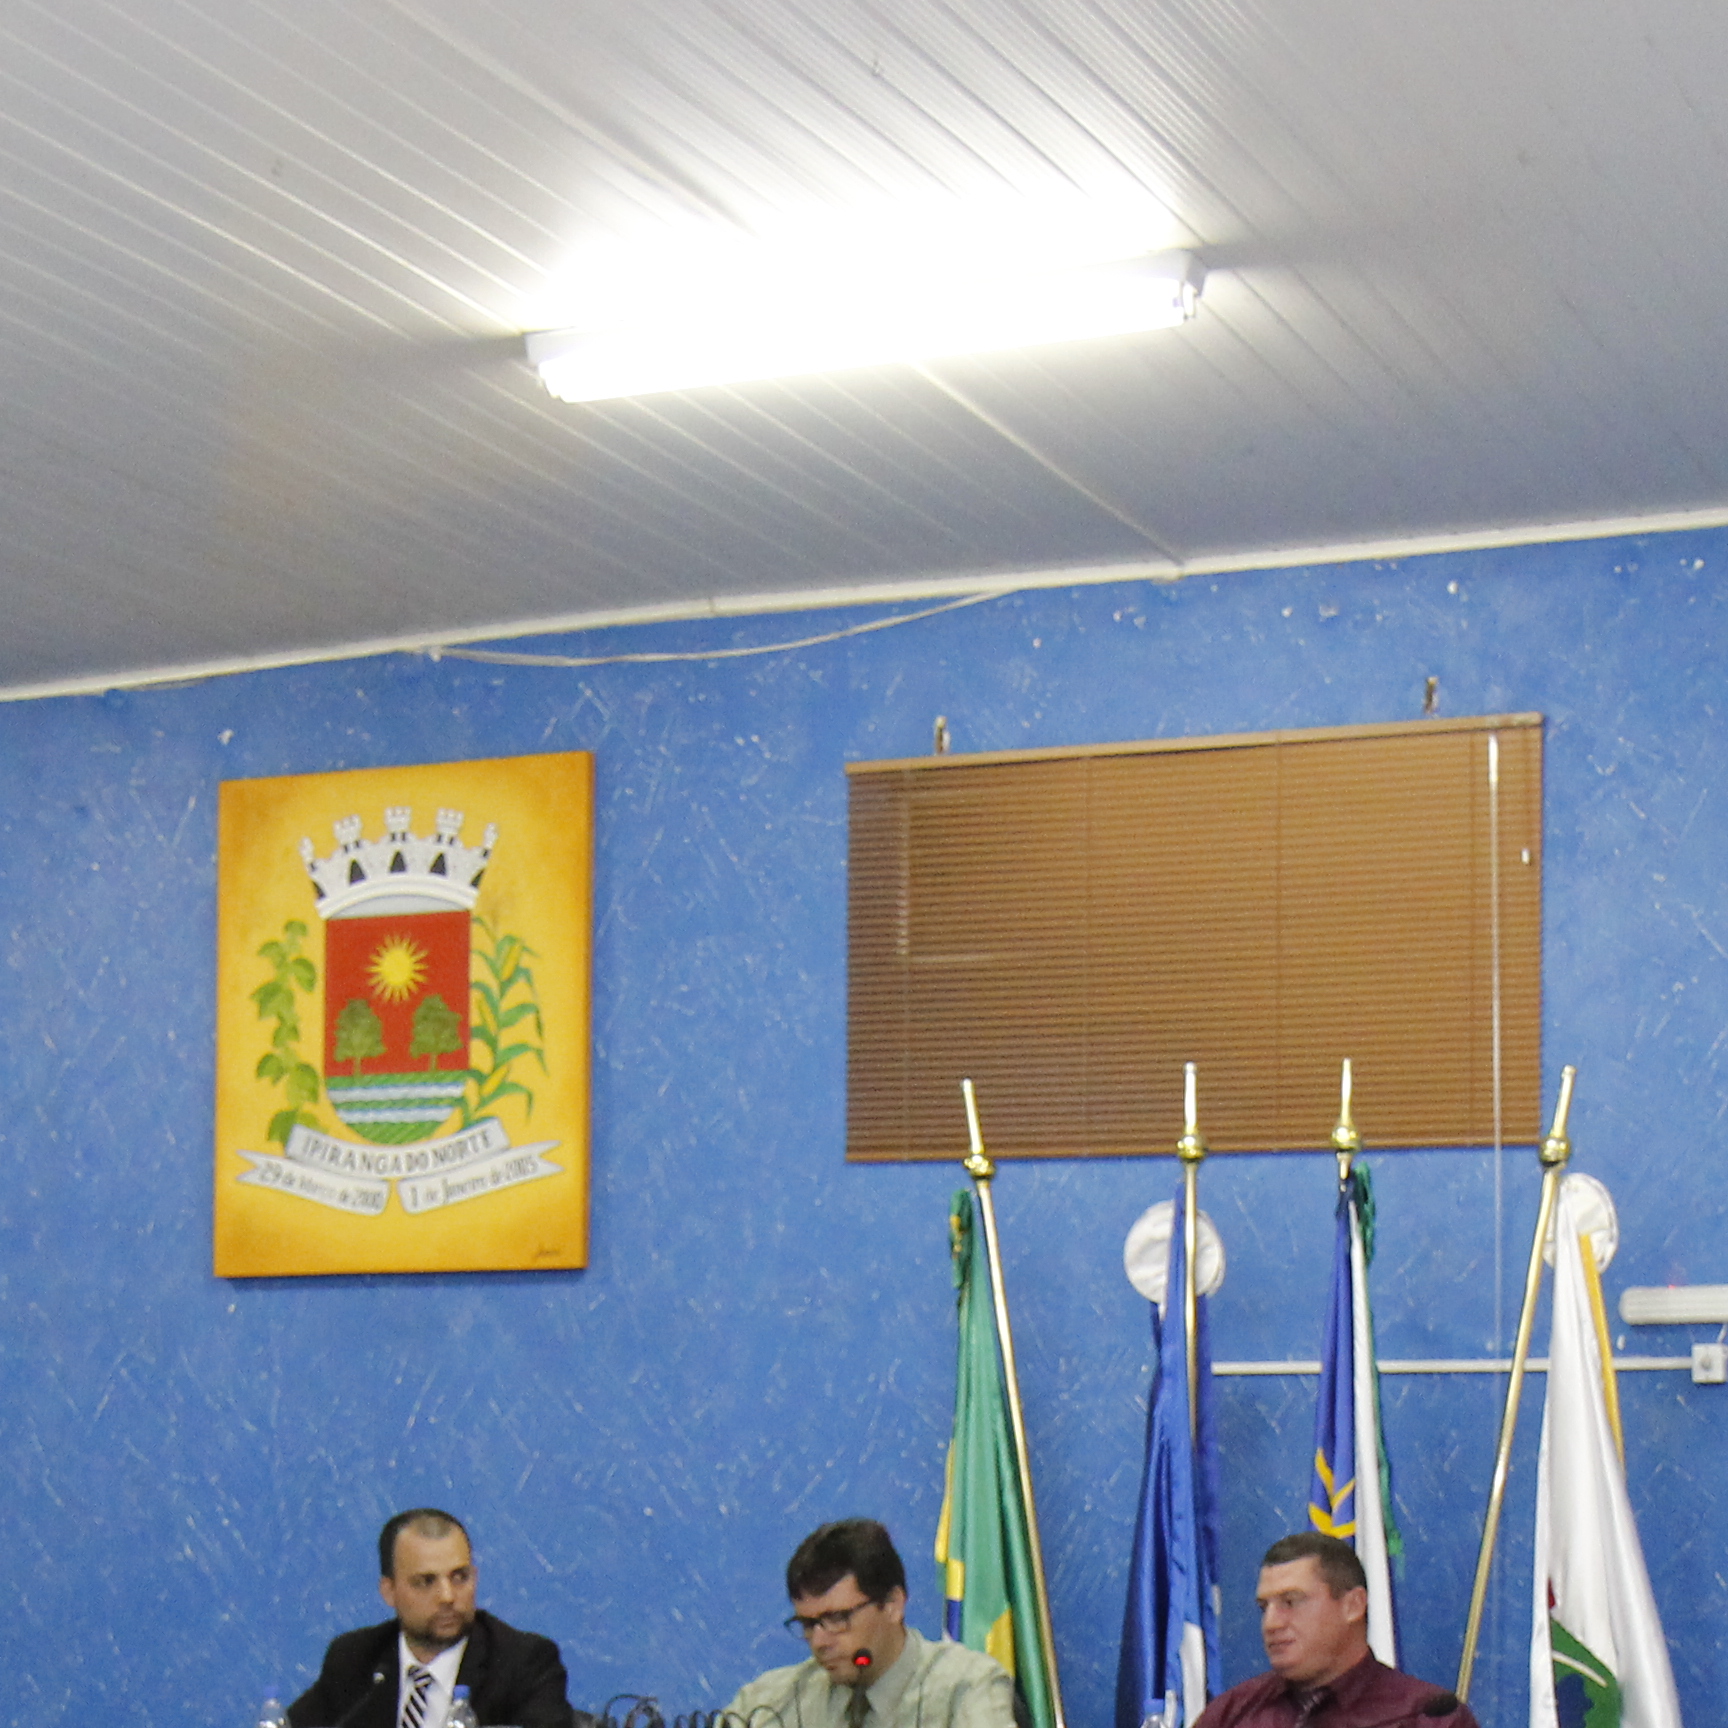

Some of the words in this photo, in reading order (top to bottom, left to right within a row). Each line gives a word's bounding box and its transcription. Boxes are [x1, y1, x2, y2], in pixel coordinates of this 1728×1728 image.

[302, 1135, 402, 1176] IPIRANGA
[405, 1151, 429, 1173] DO
[432, 1130, 492, 1168] NORTE
